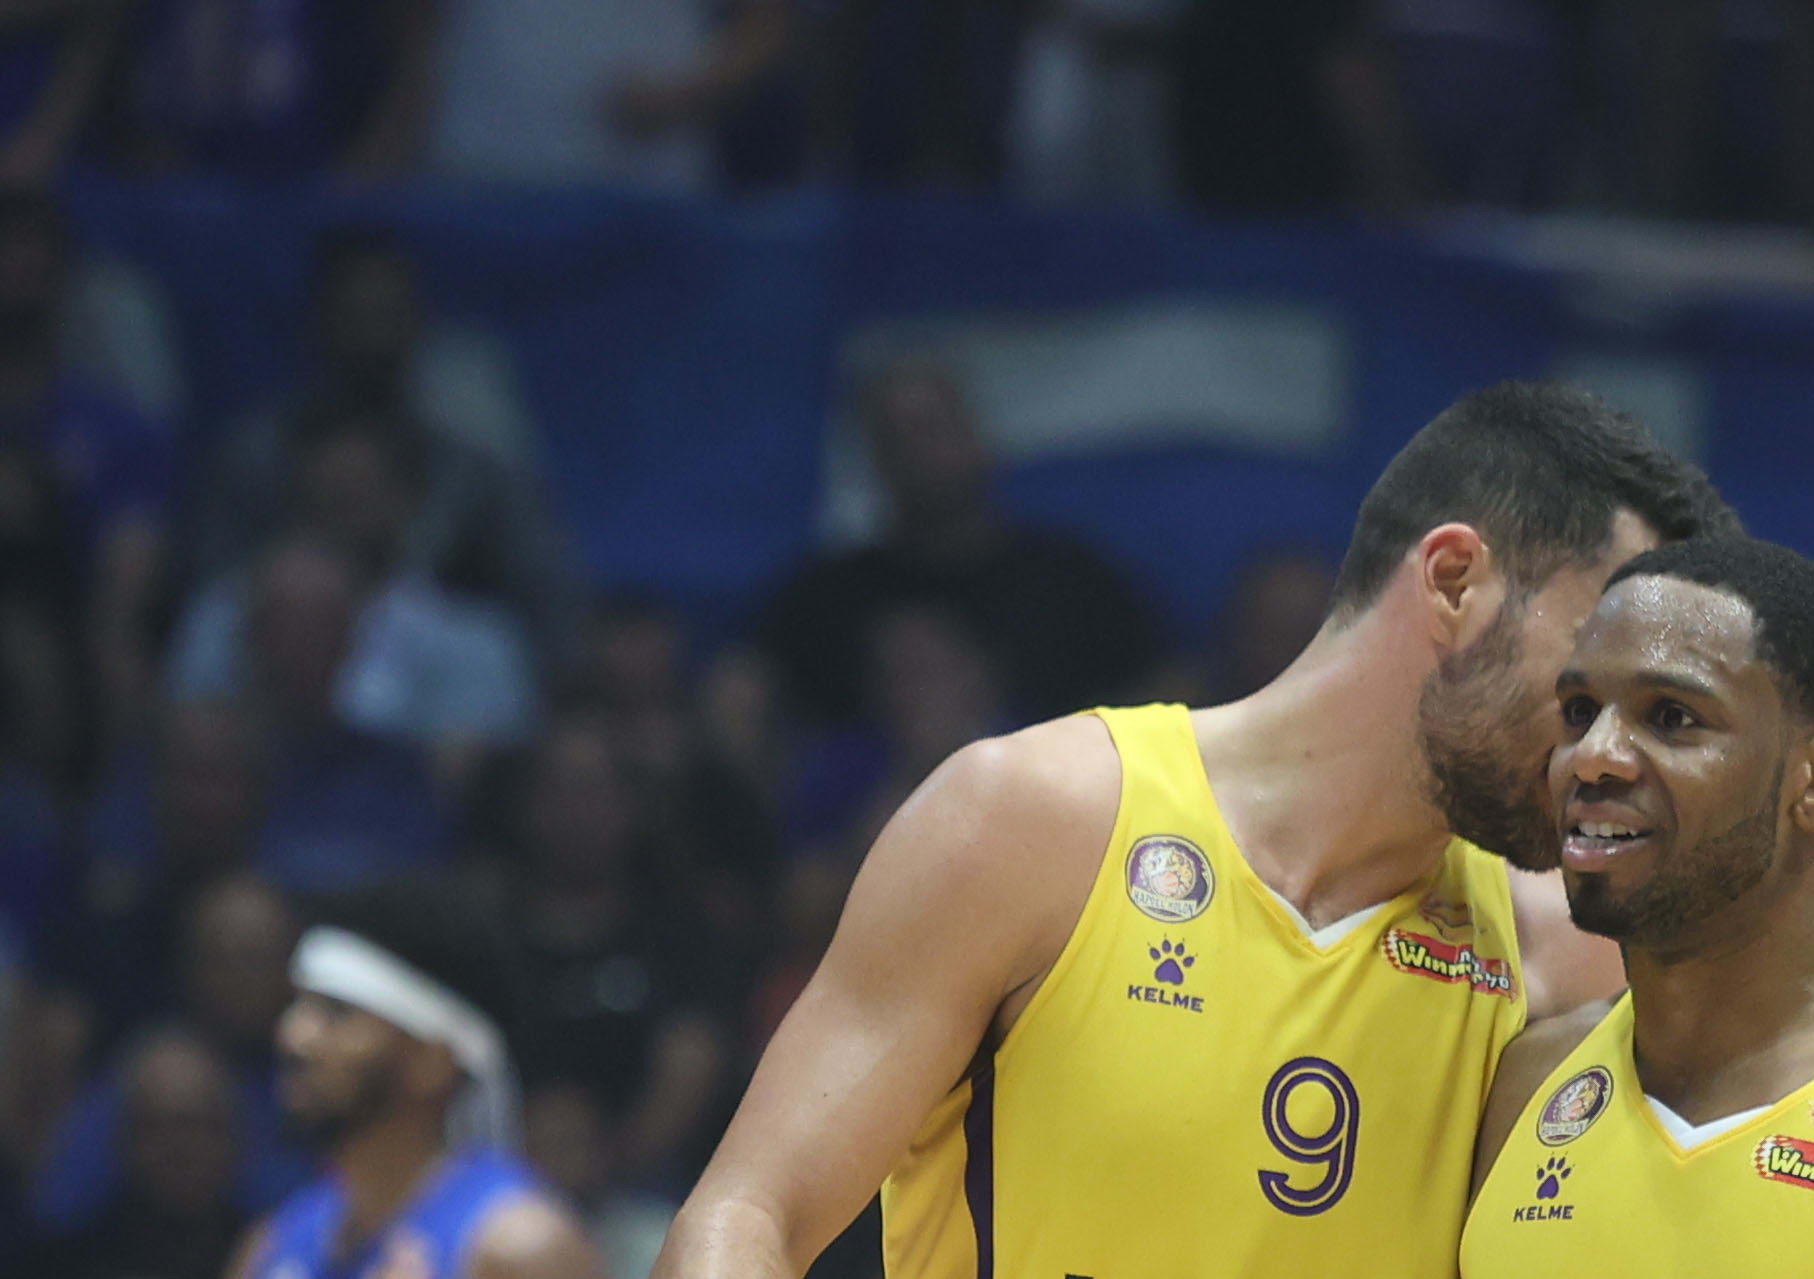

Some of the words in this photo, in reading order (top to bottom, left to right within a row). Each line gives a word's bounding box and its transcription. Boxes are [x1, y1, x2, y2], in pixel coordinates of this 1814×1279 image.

[1127, 984, 1205, 1013] KELME
[1258, 1056, 1360, 1217] 9
[1513, 1205, 1575, 1223] KELME
